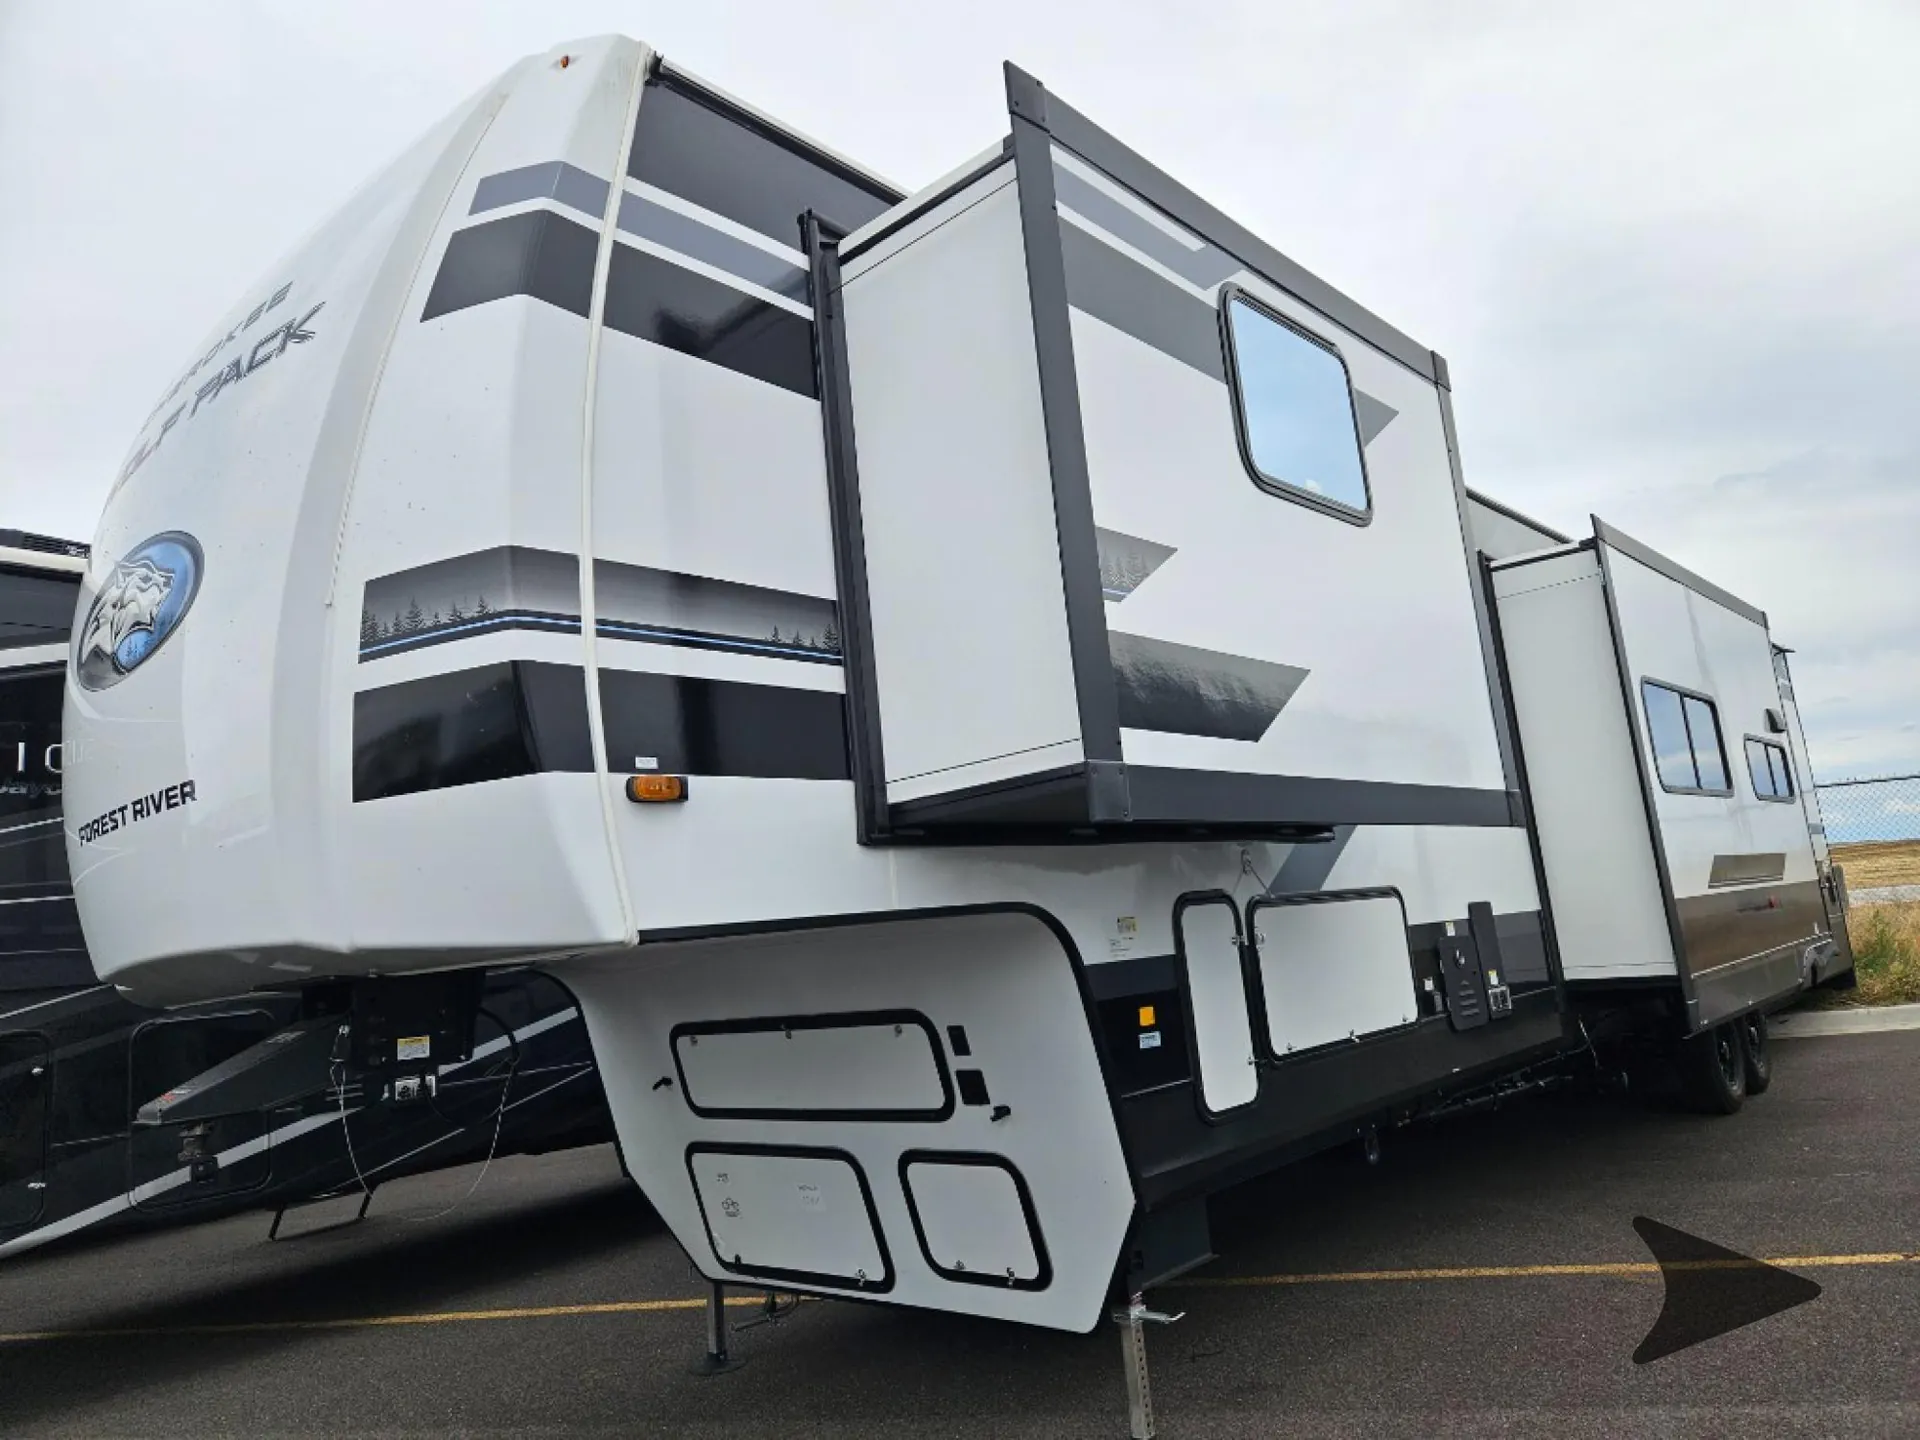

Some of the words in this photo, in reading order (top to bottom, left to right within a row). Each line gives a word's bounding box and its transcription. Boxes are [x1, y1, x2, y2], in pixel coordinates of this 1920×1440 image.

[189, 301, 326, 420] PACK
[78, 804, 128, 847] FOREST
[131, 779, 197, 822] RIVER
